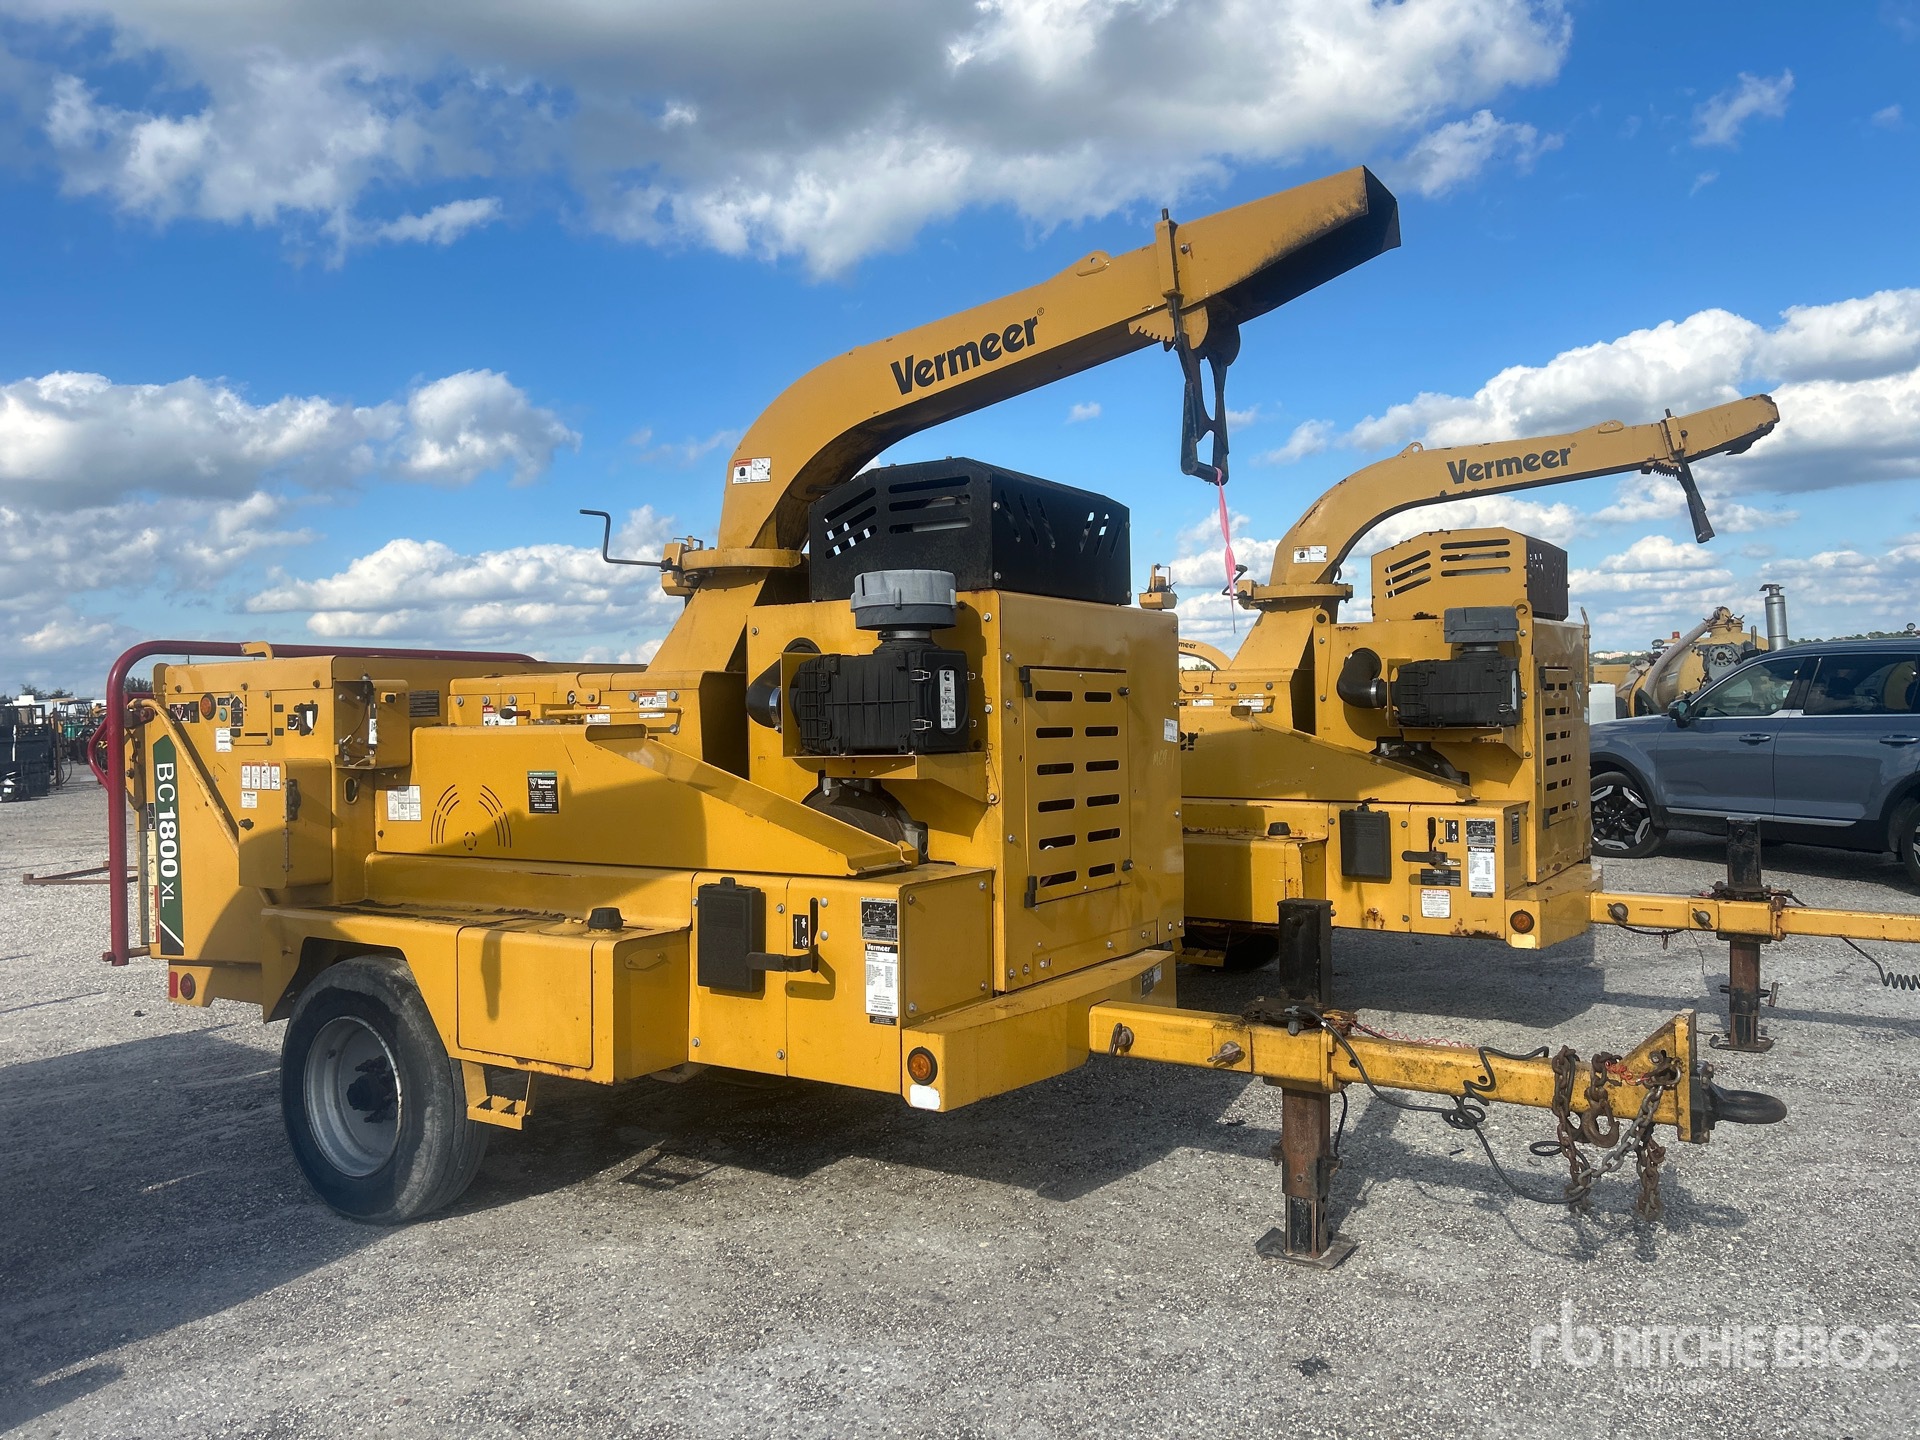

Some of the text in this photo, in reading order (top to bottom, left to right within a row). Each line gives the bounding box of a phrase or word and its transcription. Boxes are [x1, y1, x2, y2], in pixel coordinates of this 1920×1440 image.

[890, 316, 1038, 395] Vermeer
[1446, 447, 1571, 485] Vermeer
[866, 943, 892, 953] Vermeer
